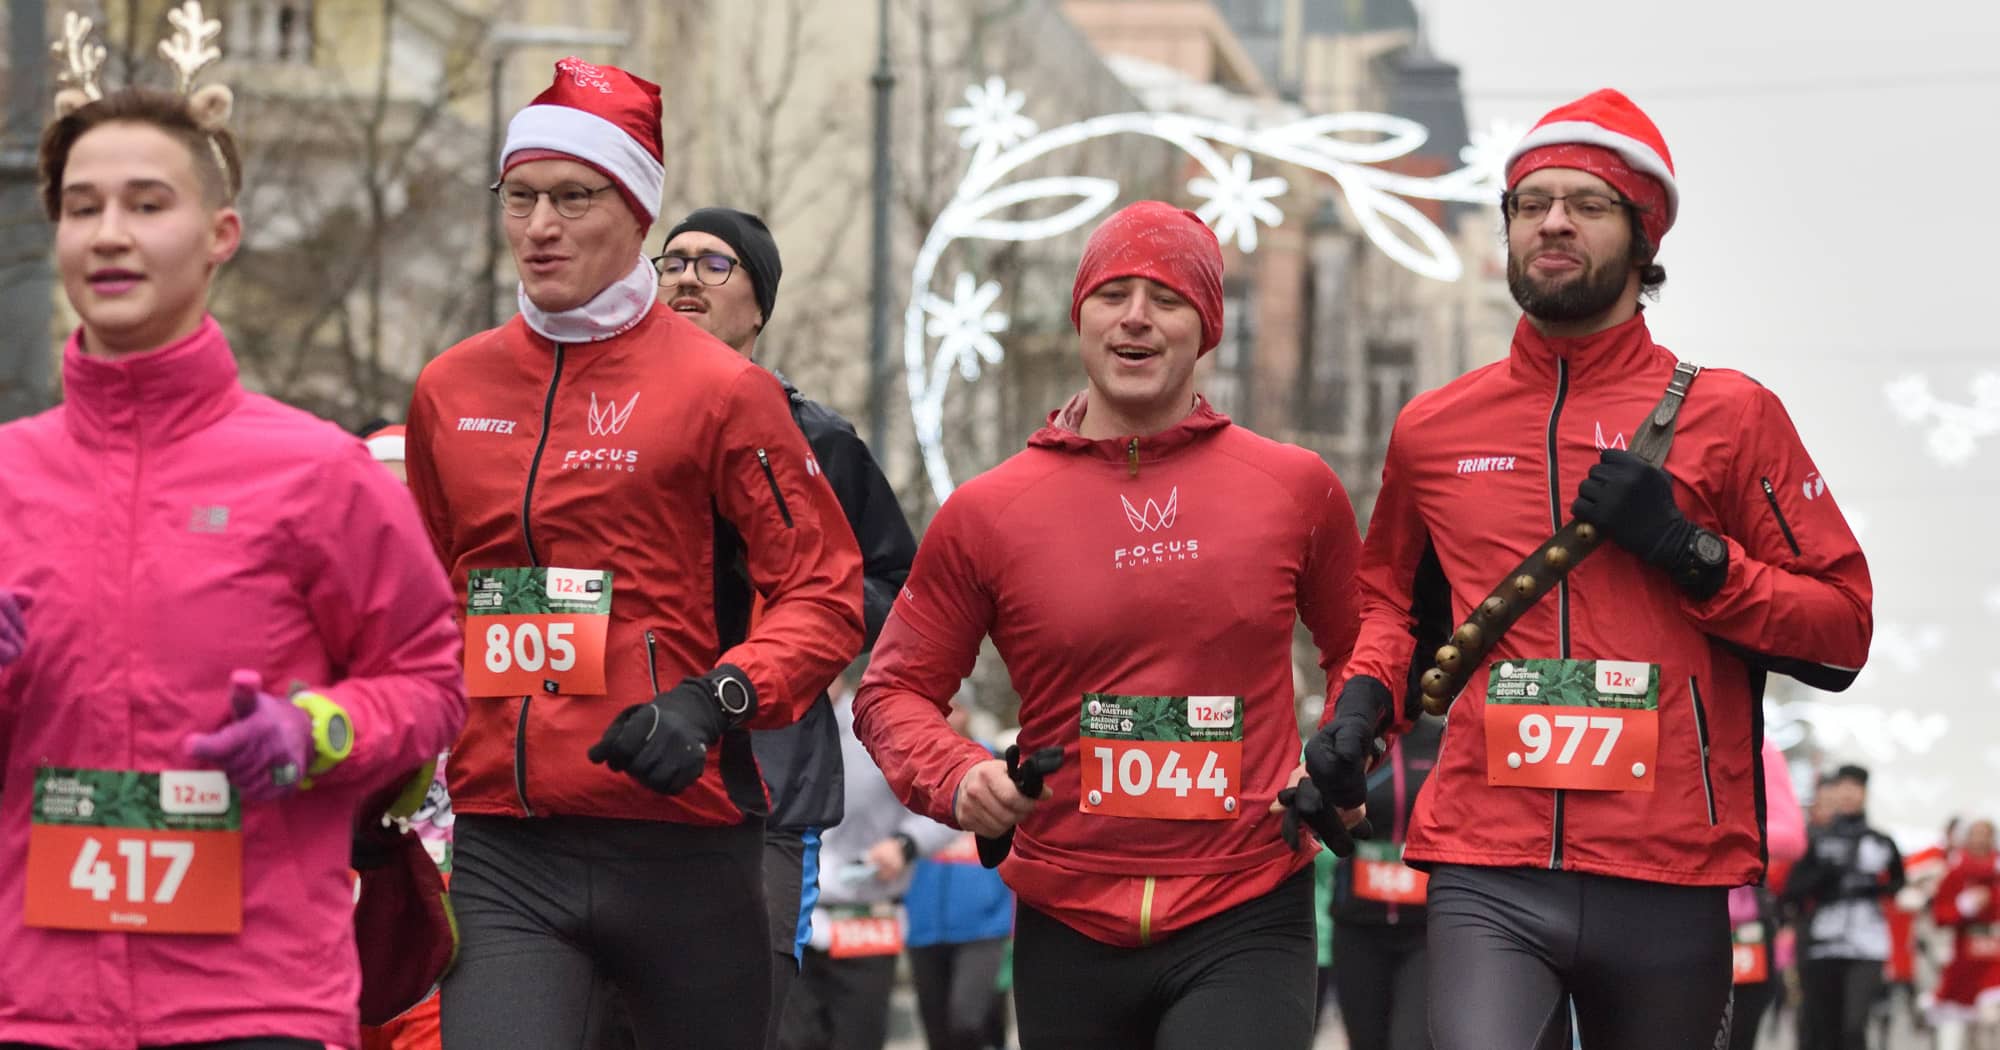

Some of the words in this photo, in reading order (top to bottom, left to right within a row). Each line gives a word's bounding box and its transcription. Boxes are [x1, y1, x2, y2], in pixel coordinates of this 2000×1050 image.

[457, 418, 516, 434] TRIMTEX
[561, 463, 635, 473] RUNNING
[1457, 456, 1516, 474] TRIMTEX
[1115, 552, 1198, 568] RUNNING
[556, 578, 573, 593] 12
[485, 623, 576, 673] 805
[1605, 671, 1622, 686] 12
[1195, 706, 1212, 720] 12
[1518, 714, 1623, 766] 977
[1094, 746, 1228, 797] 1044
[173, 784, 195, 804] 12
[69, 837, 195, 903] 417
